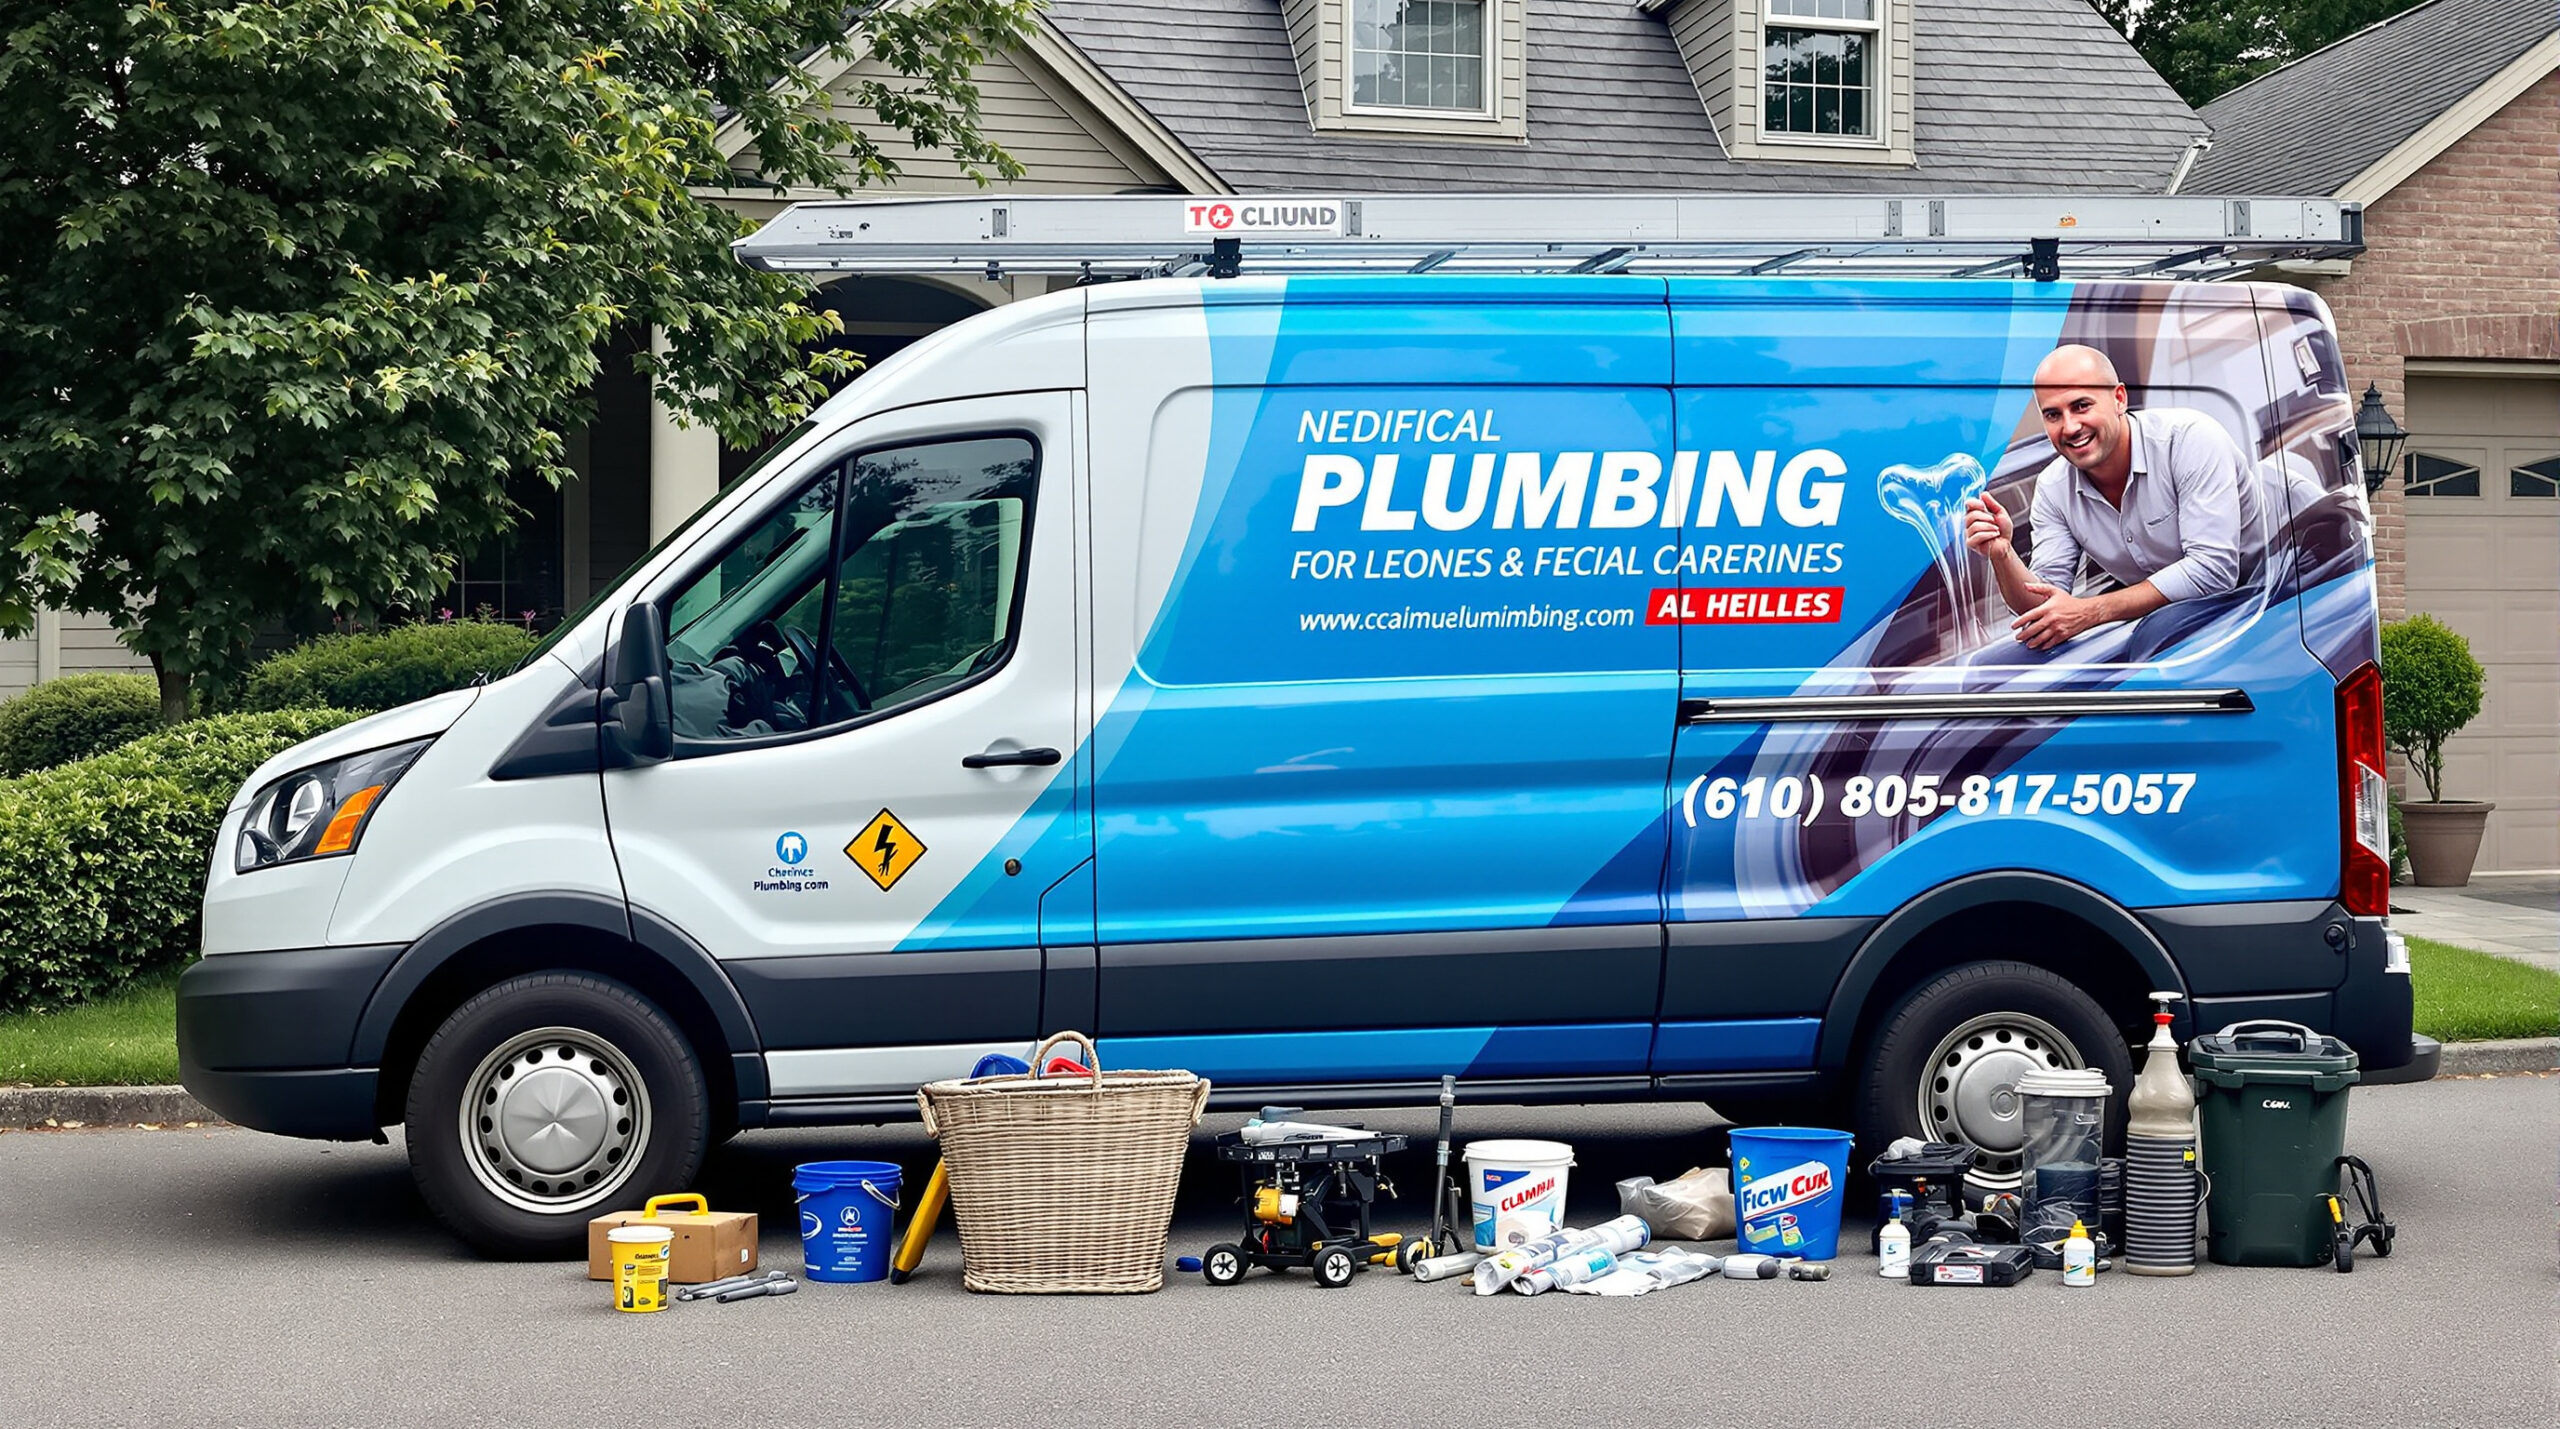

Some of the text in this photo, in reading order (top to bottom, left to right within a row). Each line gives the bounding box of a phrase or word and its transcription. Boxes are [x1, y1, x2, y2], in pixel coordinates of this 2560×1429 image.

[1241, 207, 1337, 226] CLIUND
[1297, 409, 1501, 442] NEDIFICAL
[1291, 449, 1847, 532] PLUMBING
[1291, 543, 1845, 579] FOR LEONES & FECIAL CARERINES
[1657, 593, 1831, 618] AL HEILLES
[1683, 772, 2197, 828] (610) 805-817-5057
